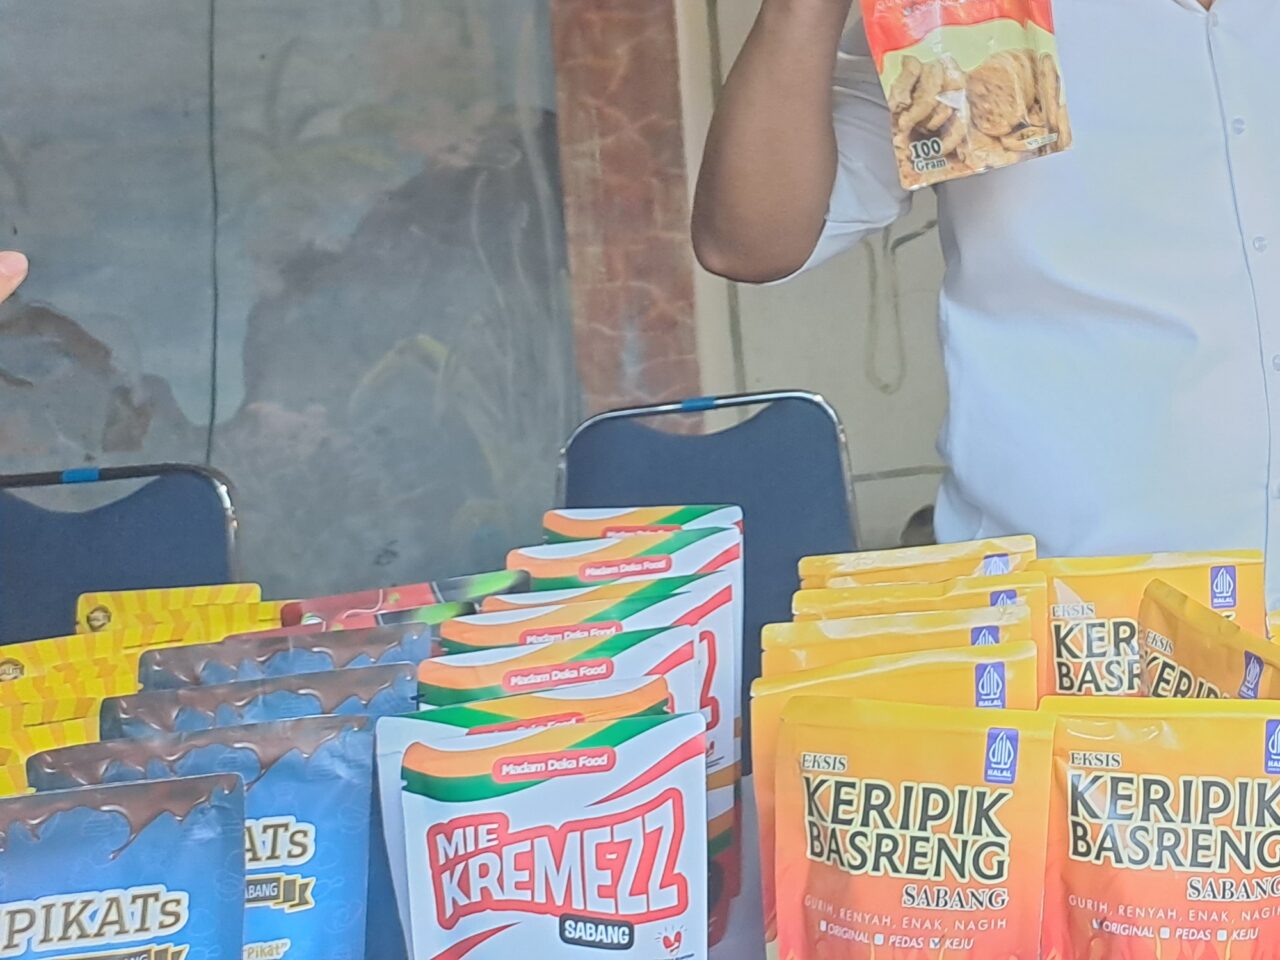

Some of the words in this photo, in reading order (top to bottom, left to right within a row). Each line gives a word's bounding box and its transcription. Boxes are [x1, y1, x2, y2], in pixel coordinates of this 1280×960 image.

[911, 141, 942, 159] 100
[914, 158, 946, 172] Gram
[1052, 604, 1094, 618] EKSIS
[1146, 631, 1174, 652] EKSIS
[510, 673, 549, 686] Madam
[579, 665, 607, 676] Food
[501, 758, 545, 775] Madam
[547, 757, 577, 771] Deka
[578, 754, 608, 767] Food
[801, 754, 847, 771] EKSIS
[1071, 752, 1121, 767] EKSIS
[987, 769, 1012, 777] HALAL
[803, 775, 1011, 838] KERIPIK
[435, 823, 499, 866] MIE
[807, 820, 1007, 881] BASRENG
[441, 798, 679, 919] KREMEZZ
[903, 885, 1007, 910] SABANG
[3, 892, 182, 950] PIKATs
[954, 918, 1008, 932] NAGIH
[1102, 922, 1155, 938] ORIGINAL
[1176, 928, 1212, 941] PEDAS
[1231, 927, 1260, 940] KEJU
[564, 920, 630, 944] SABANG
[828, 922, 870, 944] ORIGINAL
[888, 931, 925, 948] PEDAS
[944, 937, 975, 950] KEJU
